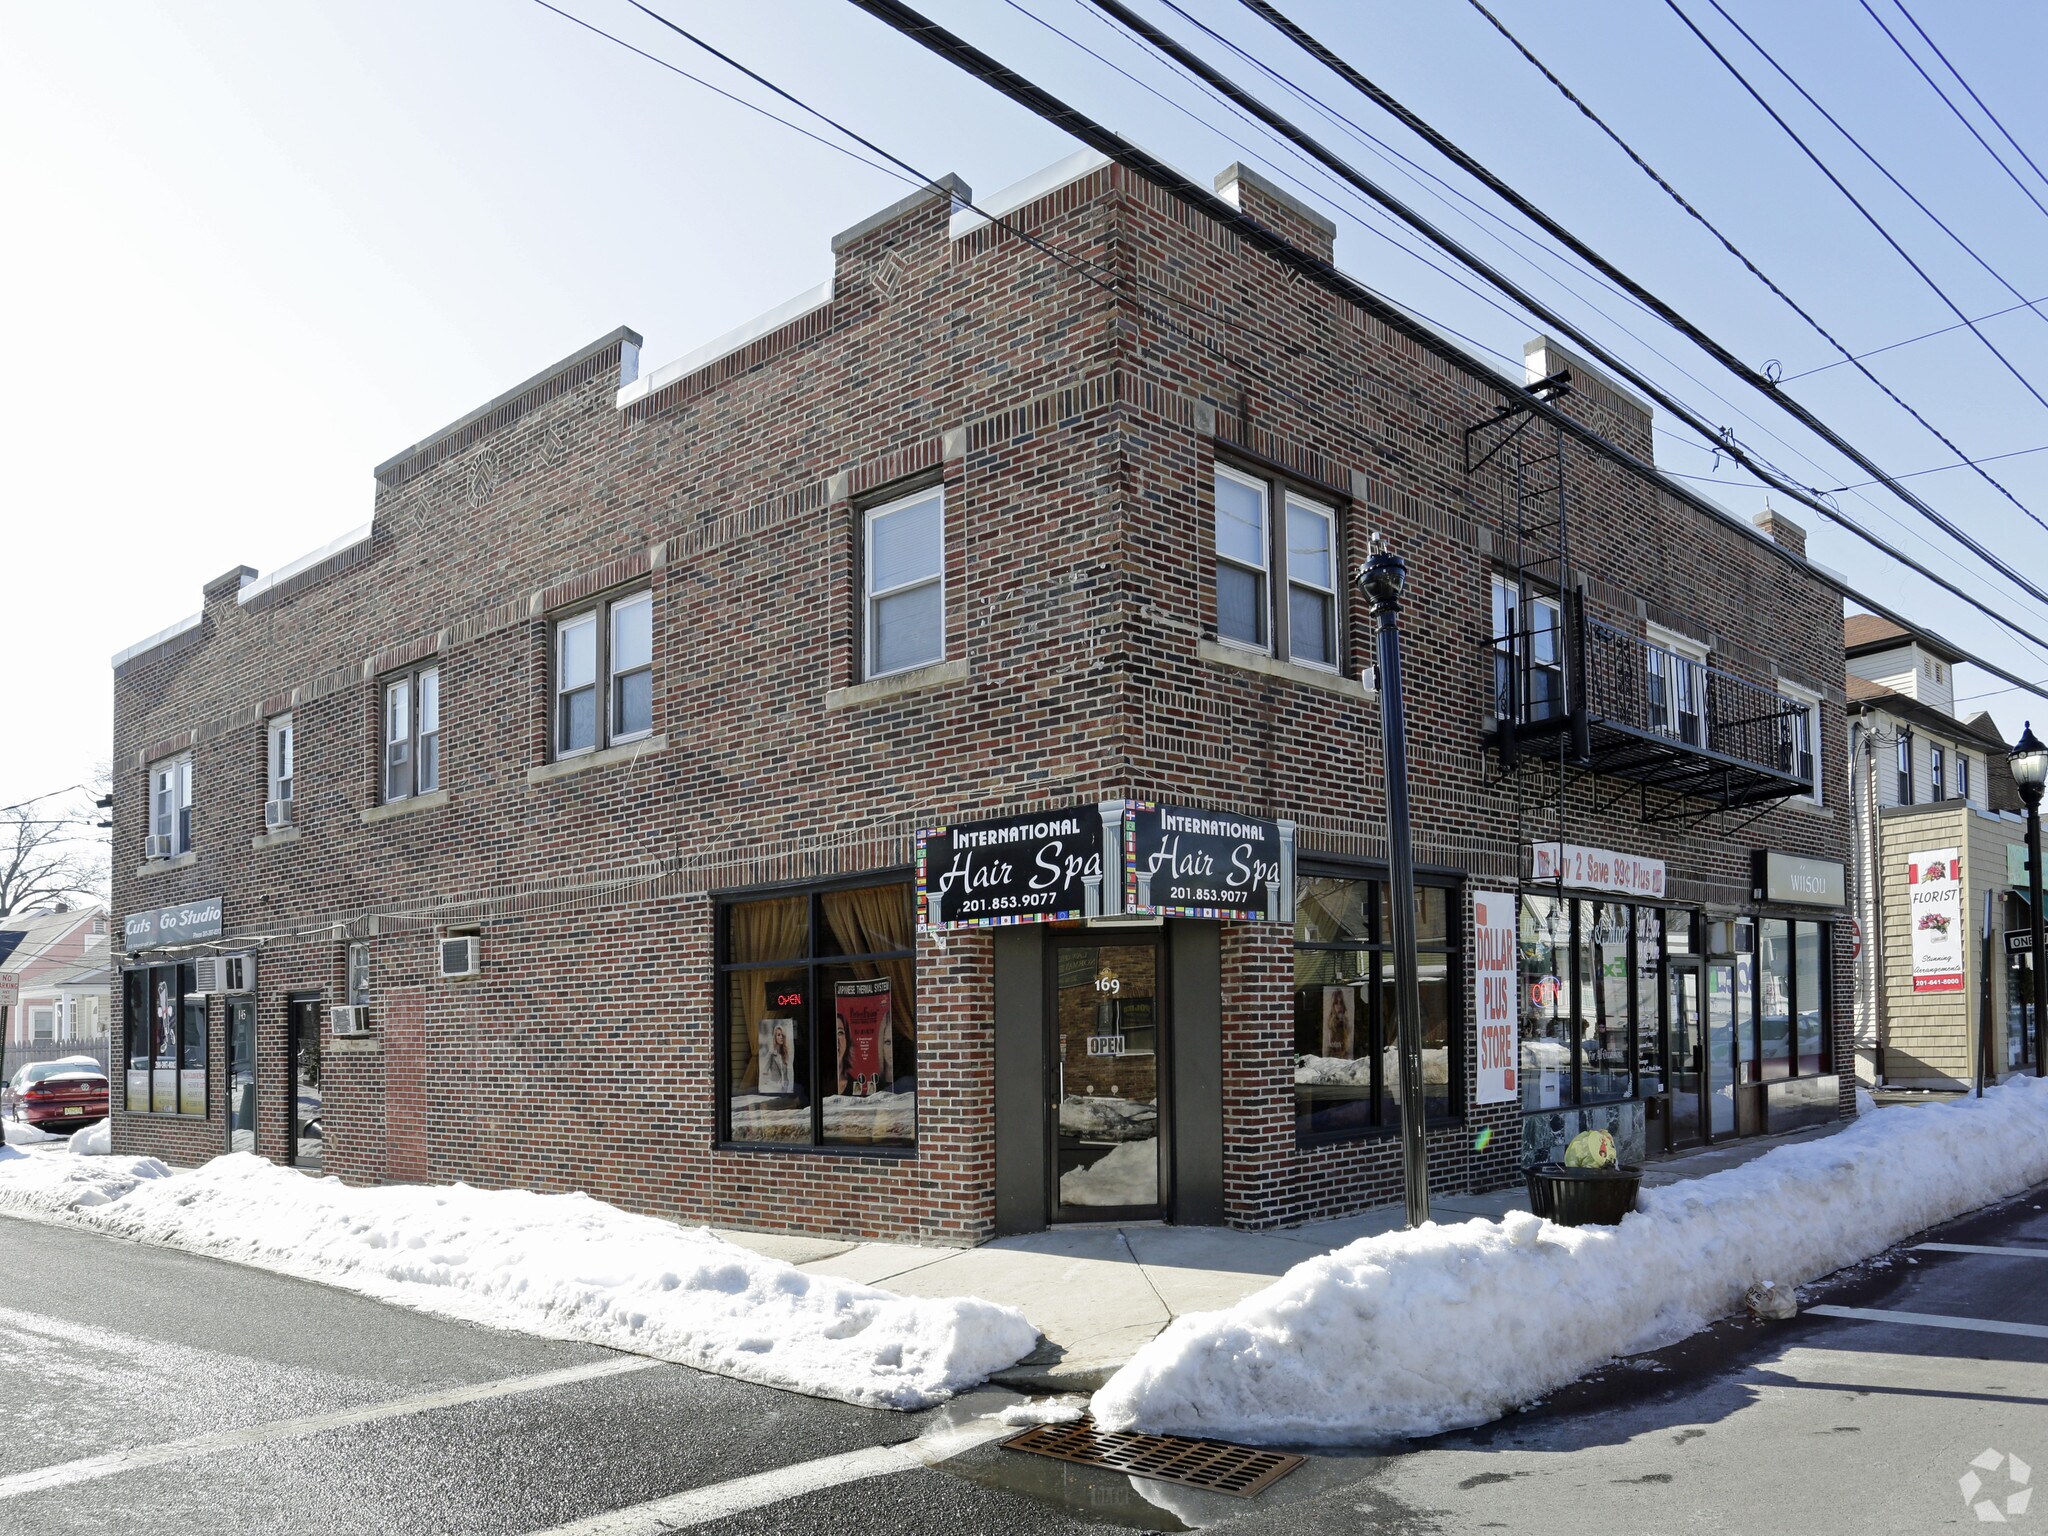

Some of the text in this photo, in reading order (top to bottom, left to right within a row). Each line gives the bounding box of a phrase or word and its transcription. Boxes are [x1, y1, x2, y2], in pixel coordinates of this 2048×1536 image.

[939, 840, 1103, 894] Hair Spa
[1148, 834, 1280, 892] Hair Spa
[1576, 852, 1582, 880] 2
[1587, 853, 1609, 884] Save
[1632, 861, 1650, 890] Plus
[962, 892, 1057, 913] 201.853.9077
[1170, 886, 1248, 903] 201.853.9077
[1912, 889, 1958, 904] FLORIST
[126, 919, 152, 936] Cuts
[160, 912, 177, 930] Go
[179, 905, 221, 927] Studio
[1477, 927, 1513, 971] DOLLAR
[1922, 954, 1952, 963] Stunning
[1913, 965, 1961, 974] Arrangements
[856, 984, 874, 994] THERMAL
[874, 982, 890, 992] SYSTEM
[1094, 977, 1120, 994] 169
[1916, 978, 1960, 987] 201-641-8000
[777, 993, 802, 1005] OPEN
[1483, 976, 1508, 1020] PLUS
[1090, 1037, 1123, 1054] OPEN
[1481, 1025, 1512, 1070] STORE
